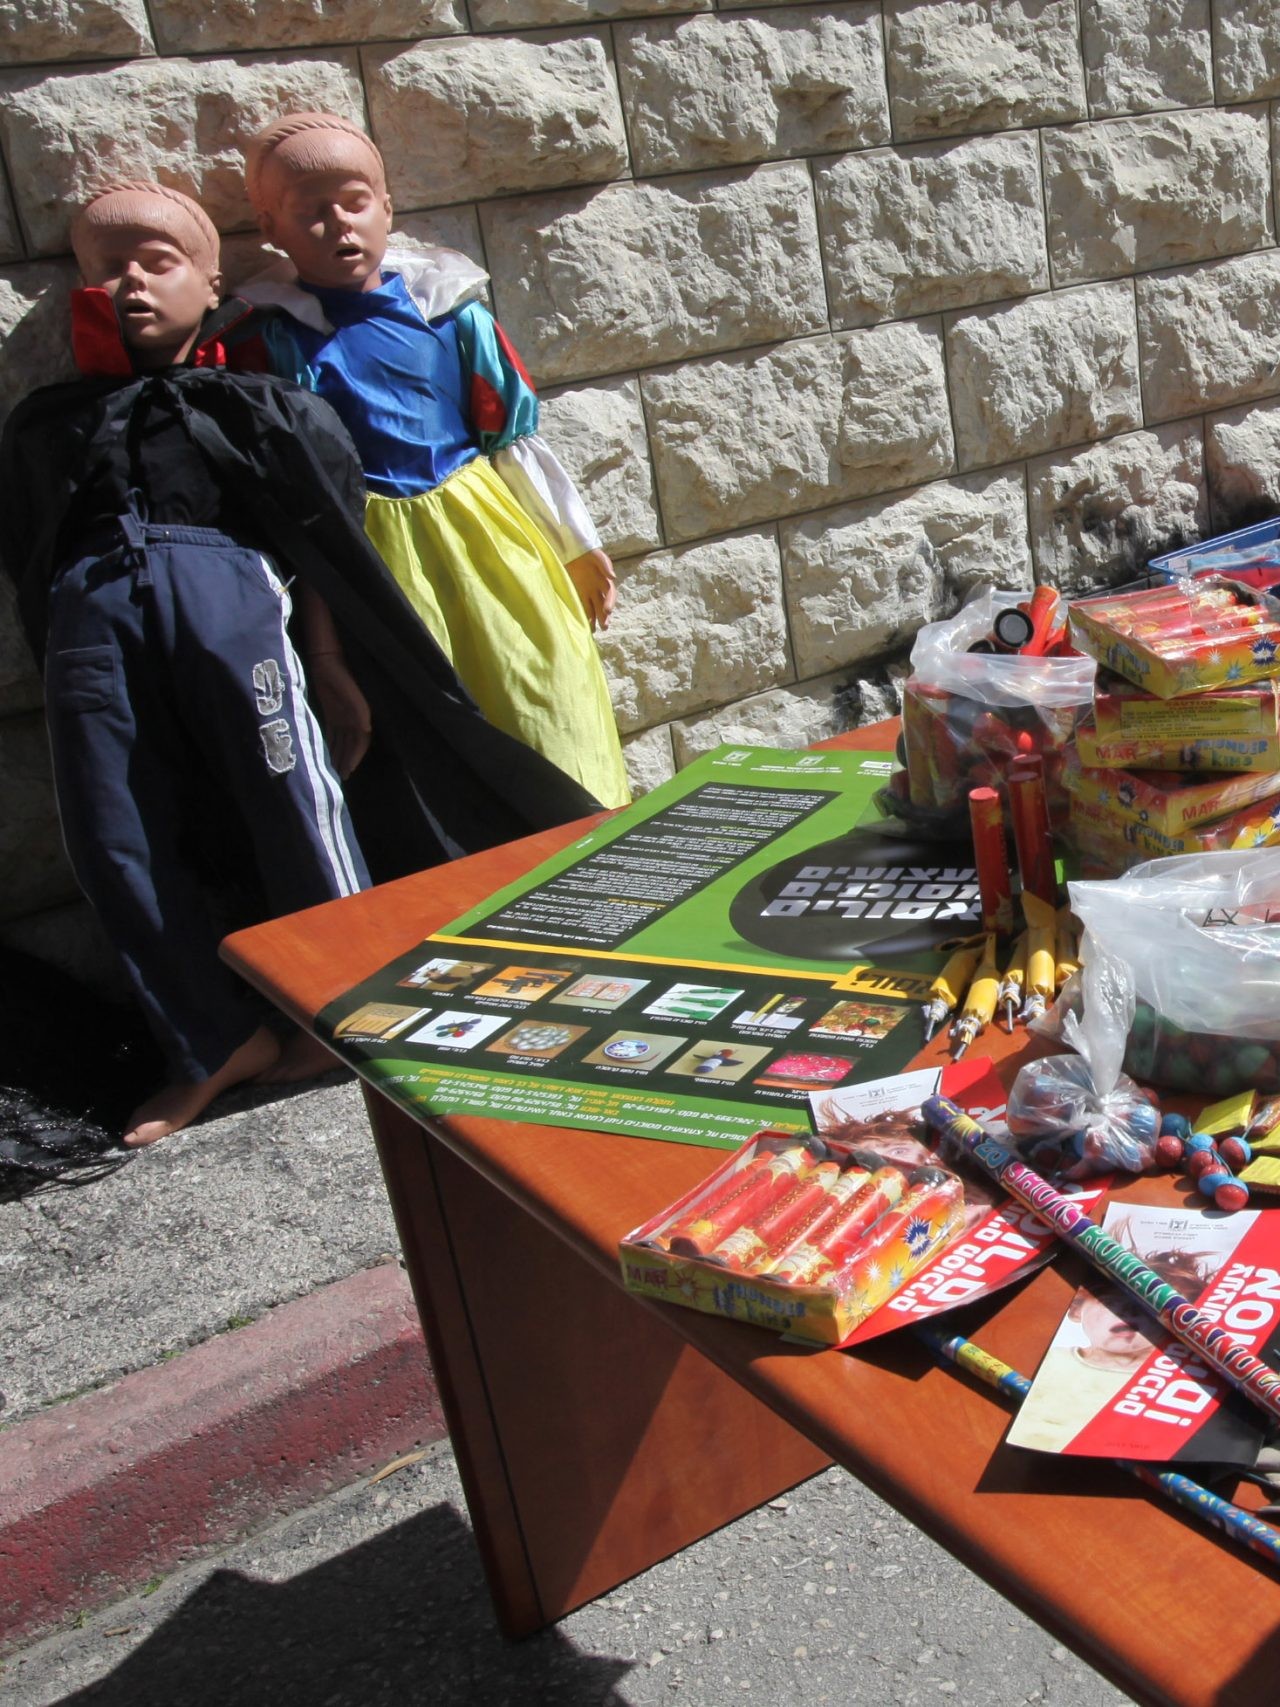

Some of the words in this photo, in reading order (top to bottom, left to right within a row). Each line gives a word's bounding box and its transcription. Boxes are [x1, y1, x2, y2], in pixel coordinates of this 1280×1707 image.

[795, 865, 979, 881] עצועים
[759, 899, 981, 921] אסורים
[1000, 1160, 1086, 1234] SHOTS
[1076, 1224, 1186, 1313] ROMAN
[886, 1243, 983, 1312] מסוכנים
